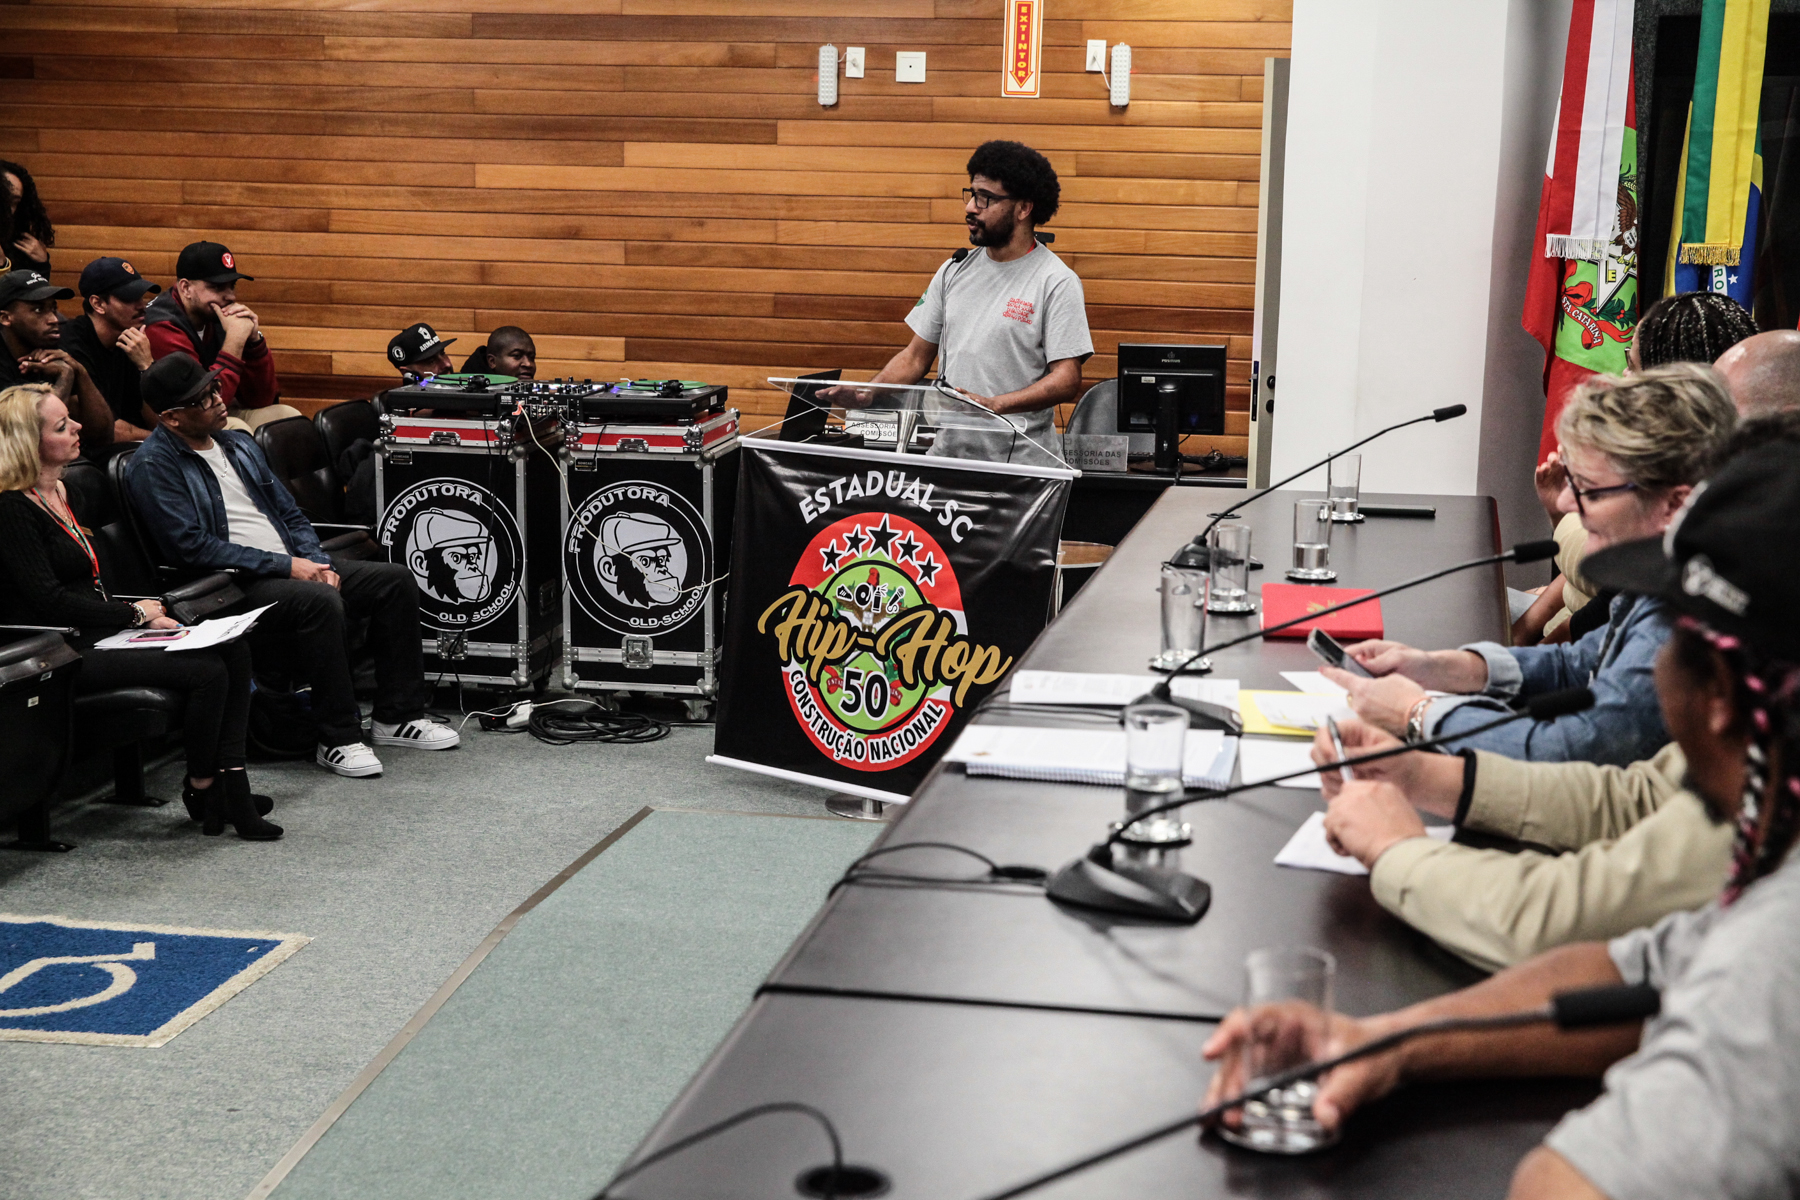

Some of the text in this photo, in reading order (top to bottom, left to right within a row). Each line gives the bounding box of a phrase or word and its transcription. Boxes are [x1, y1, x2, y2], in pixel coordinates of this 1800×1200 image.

[1017, 6, 1028, 77] EXTINTOR
[1571, 309, 1602, 344] CATARINA
[852, 421, 896, 430] ASSESSORIA
[860, 429, 897, 438] COMISSÕE
[1105, 450, 1122, 458] DAS
[382, 483, 482, 546] PRODUTORA
[569, 486, 669, 553] PRODUTORA
[799, 470, 974, 544] ESTADUAL SC
[439, 580, 515, 623] OLD SCHOOL
[629, 616, 660, 627] OLD
[757, 589, 1013, 708] Hip-Hop
[790, 669, 944, 761] CONSTRUÇÃO NACIONAL
[839, 667, 891, 720] 50
